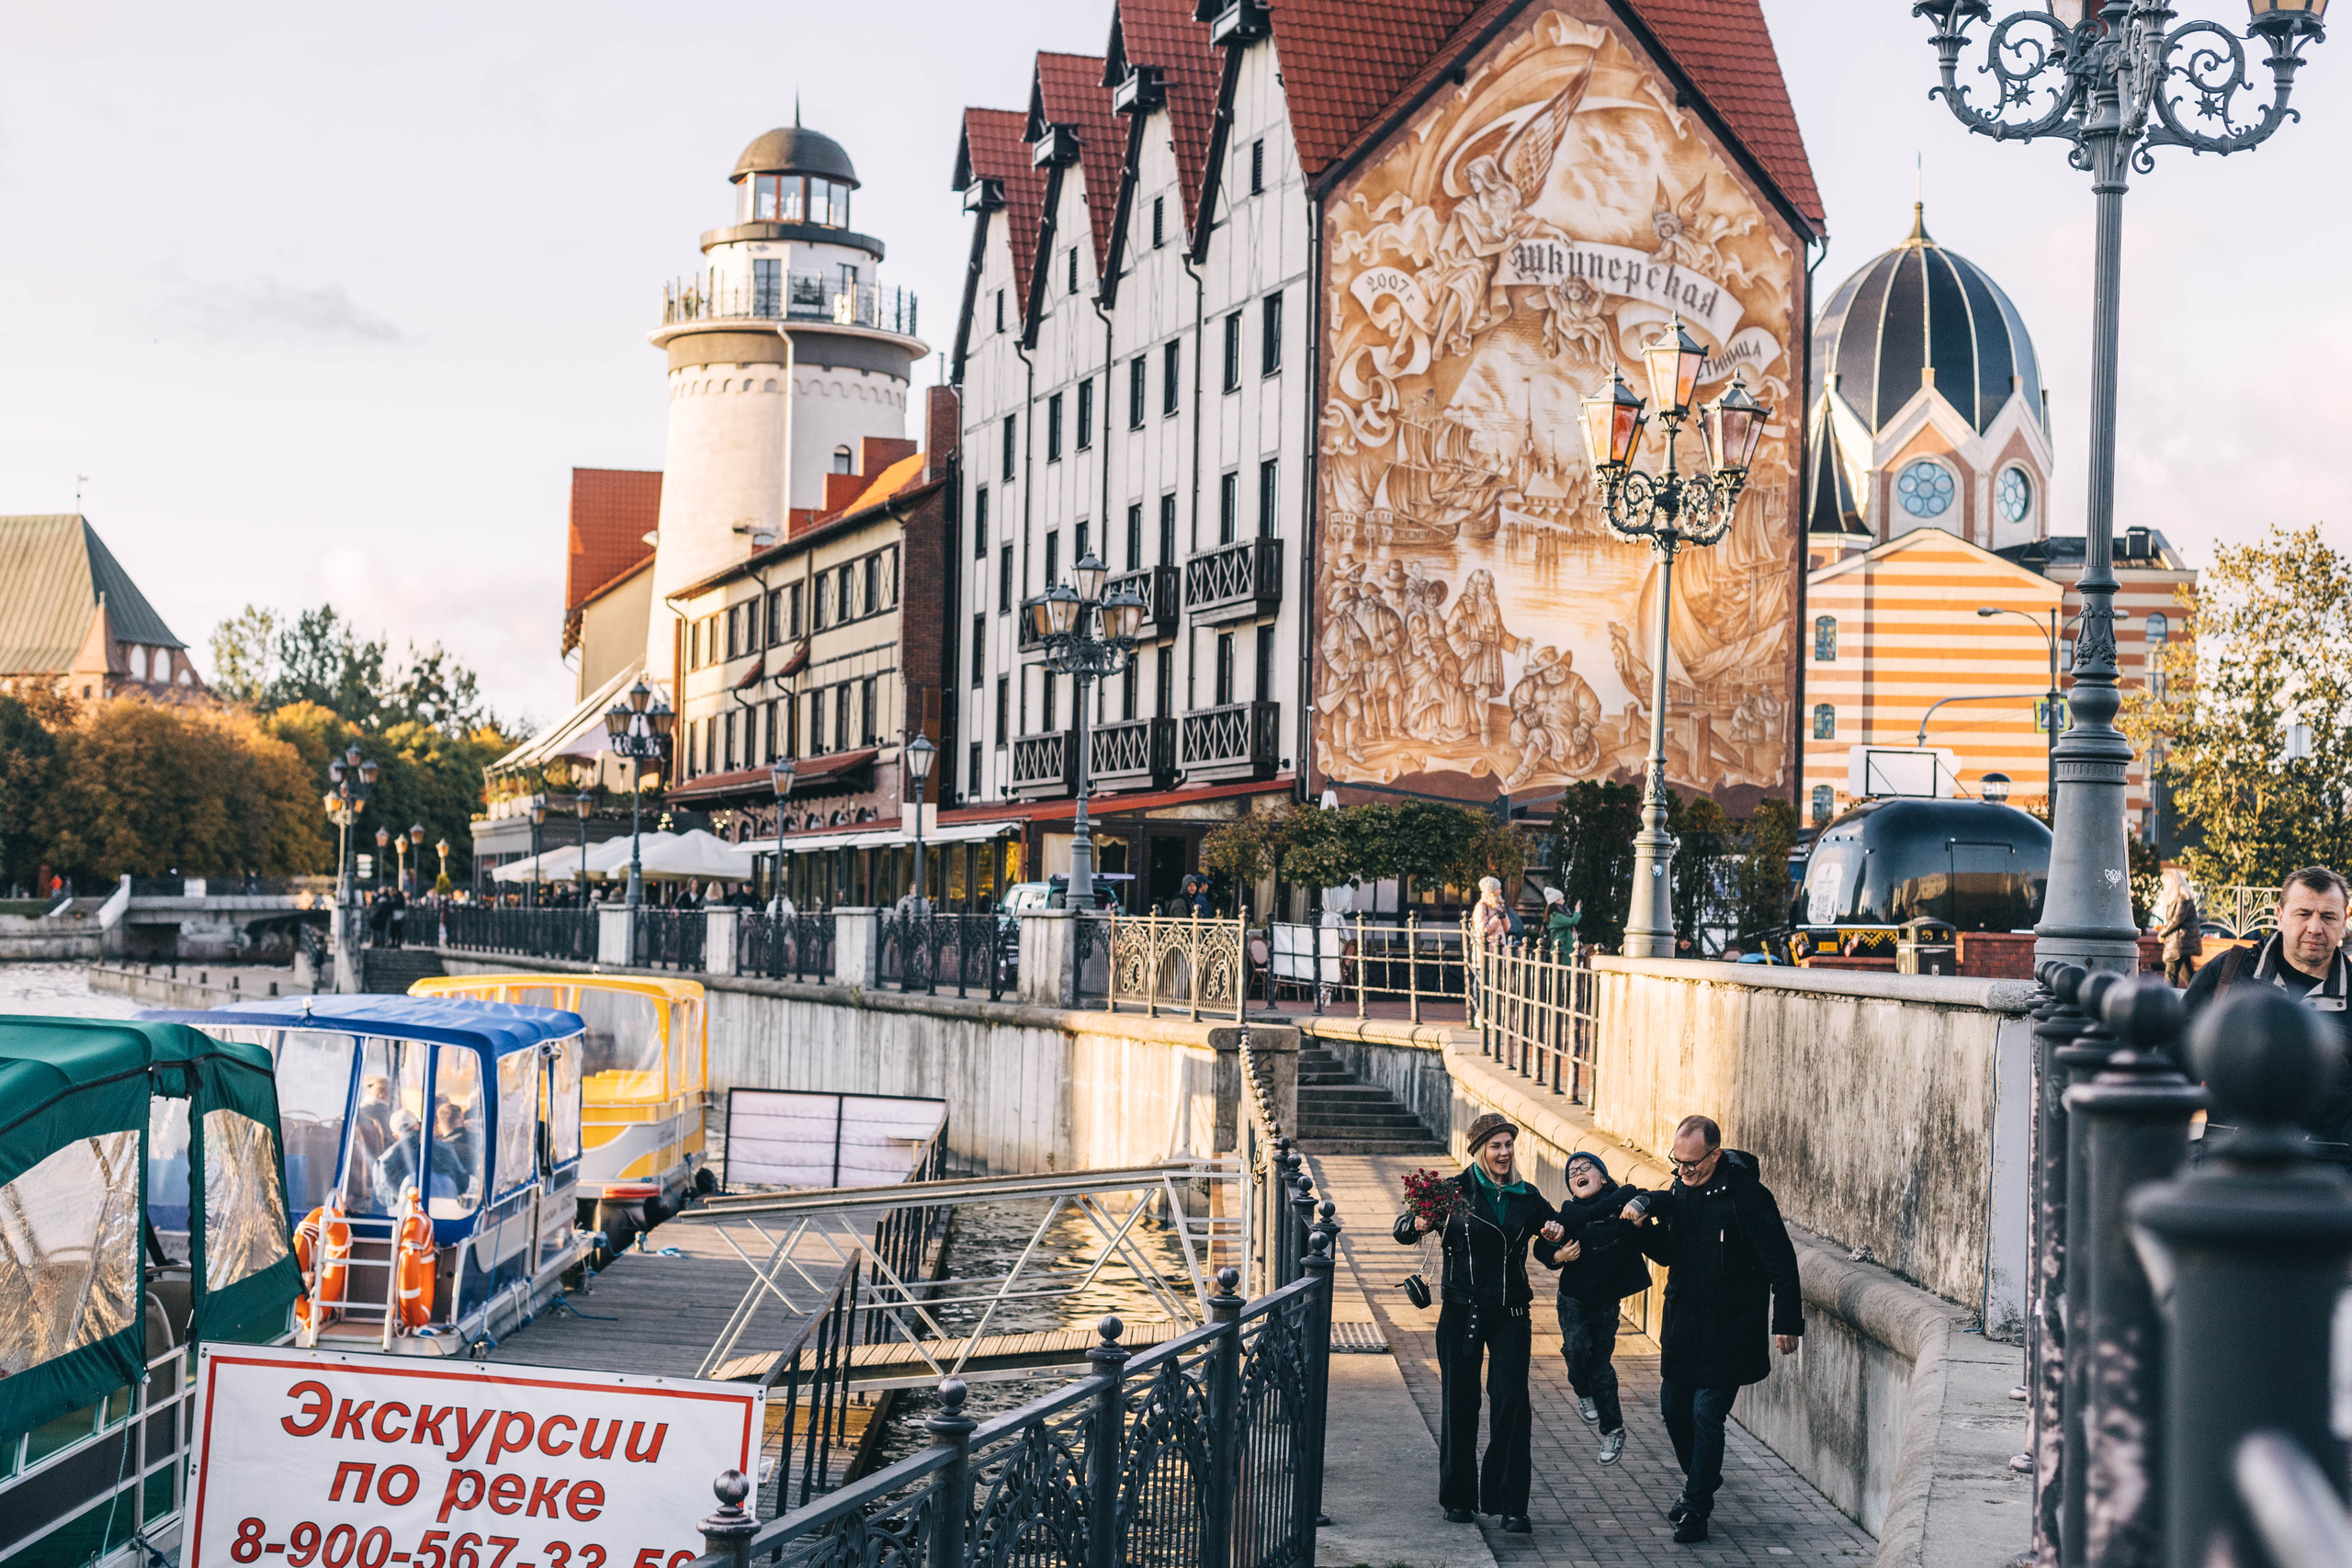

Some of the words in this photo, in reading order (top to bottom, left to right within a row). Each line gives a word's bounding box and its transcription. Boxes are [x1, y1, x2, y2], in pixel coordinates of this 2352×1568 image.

[1366, 273, 1410, 293] 2007
[1508, 241, 1720, 319] Шкиперская
[279, 1380, 669, 1464] Экскурсии
[328, 1461, 420, 1506] по
[435, 1468, 606, 1524] реке
